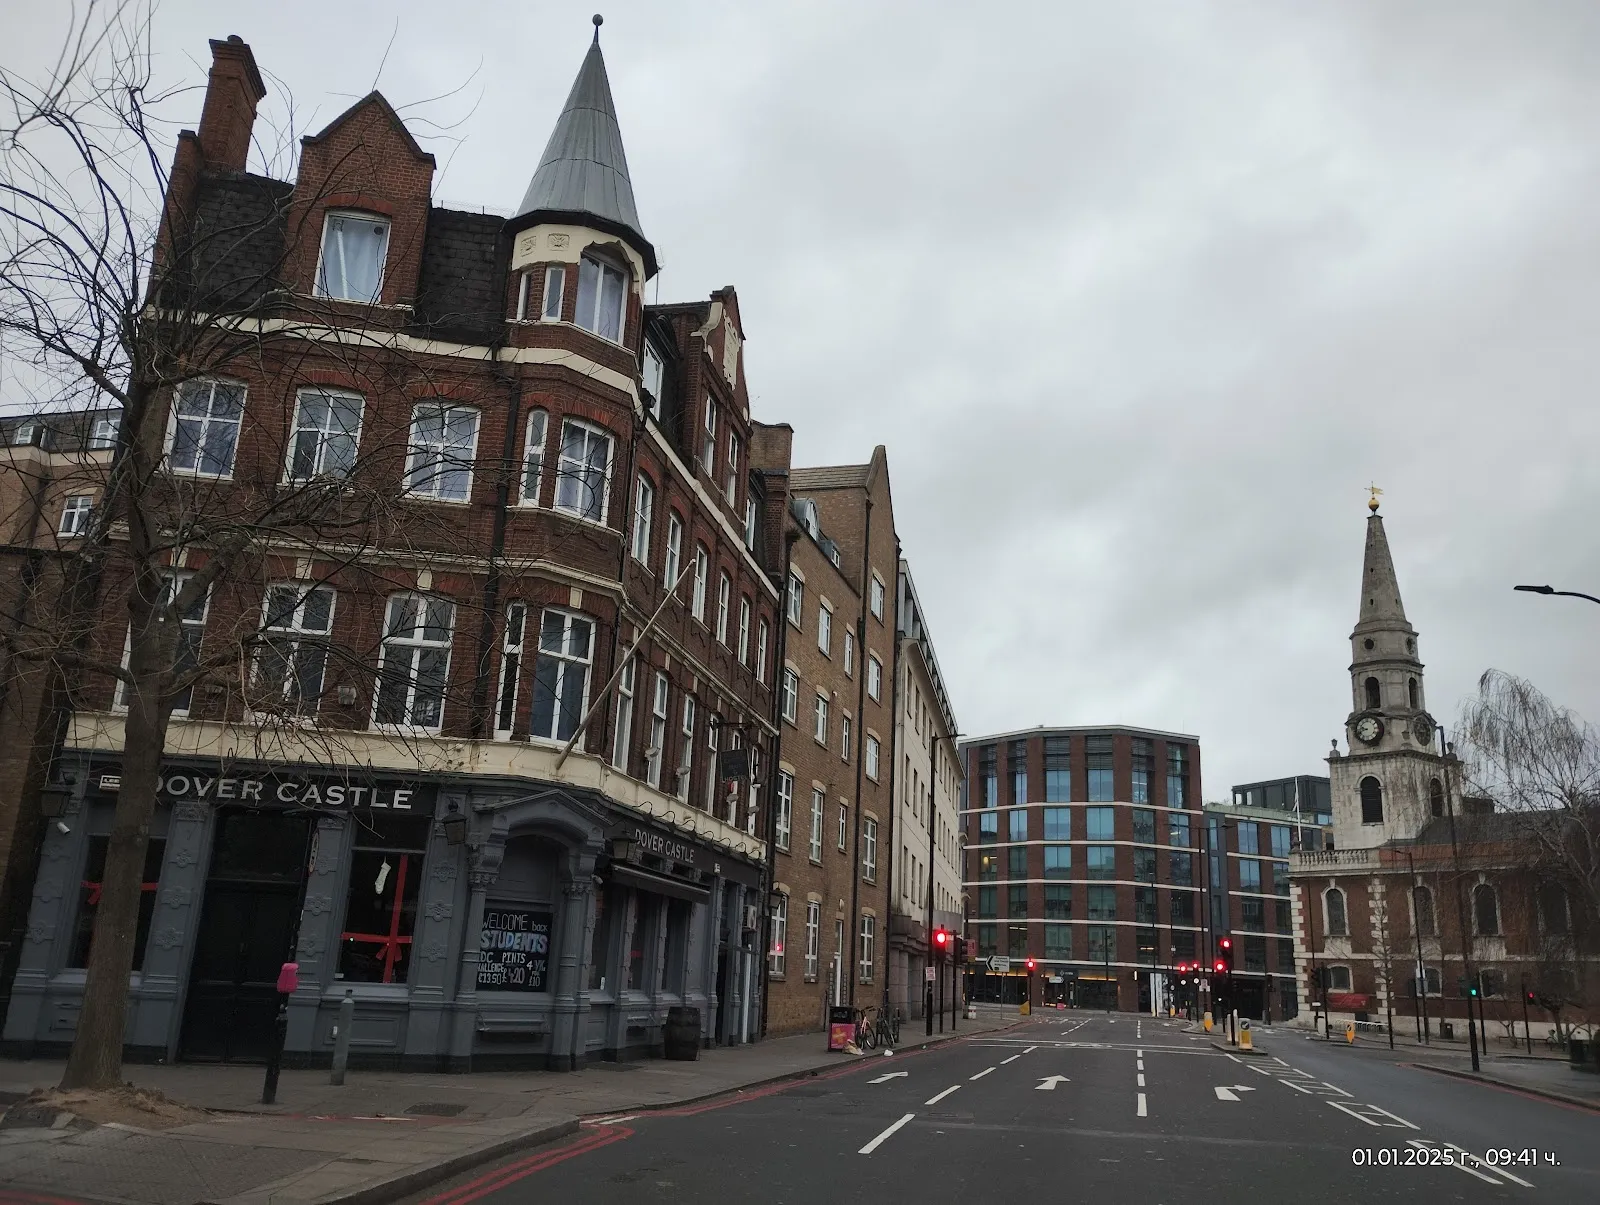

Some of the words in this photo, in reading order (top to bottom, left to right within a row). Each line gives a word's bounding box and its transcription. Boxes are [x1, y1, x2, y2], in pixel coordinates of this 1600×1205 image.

[276, 782, 413, 809] CASTLE
[635, 828, 664, 853] DOVER
[665, 840, 695, 864] CASTLE
[482, 912, 528, 931] WELCOME
[532, 921, 548, 932] back
[480, 930, 548, 954] STUDENTS
[502, 951, 526, 964] PINTS
[526, 960, 533, 970] 4
